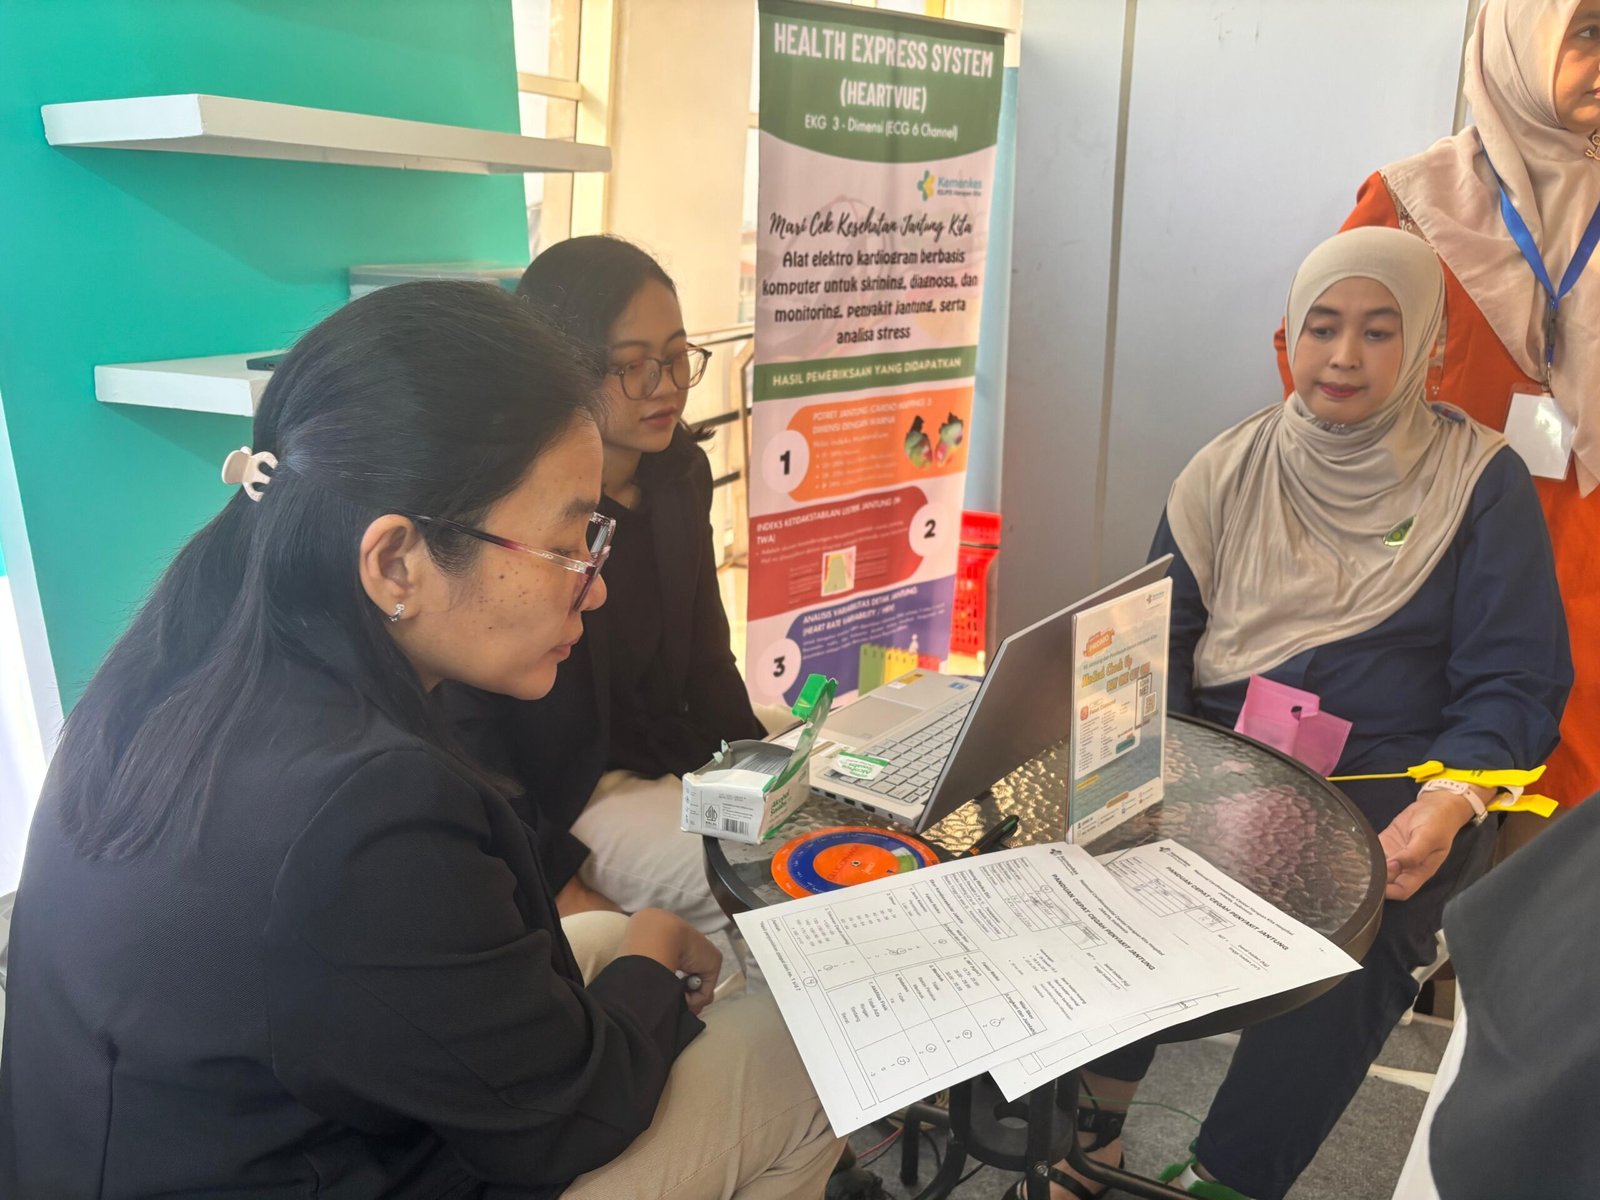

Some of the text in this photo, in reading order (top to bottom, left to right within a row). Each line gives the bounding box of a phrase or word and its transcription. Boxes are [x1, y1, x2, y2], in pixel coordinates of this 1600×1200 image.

[774, 22, 993, 78] HEALTH EXPRESS SYSTEM
[840, 78, 927, 113] (HEARTVUE)
[804, 113, 827, 130] EKG
[832, 117, 839, 131] 3
[848, 117, 884, 134] Dimensi
[885, 120, 909, 137] (ECG
[912, 123, 919, 136] 6
[921, 122, 958, 141] Channel)
[769, 206, 973, 243] Mari Cek Kesehatan Jantung Kita
[783, 249, 965, 268] Alat elektro kardiogram berbasis
[762, 279, 821, 296] komputer
[824, 279, 858, 293] untuk
[861, 275, 907, 292] skrining,
[961, 273, 978, 287] dan
[847, 302, 892, 318] penyakit
[940, 299, 966, 313] serta
[836, 326, 911, 344] analisa stress
[773, 357, 962, 387] HASIL PEMERIKSAAN YANG DIDAPATKAN
[780, 450, 791, 475] 1
[757, 520, 783, 532] INDEKS
[861, 499, 892, 512] JANTUNG
[924, 519, 936, 539] 2
[803, 612, 832, 624] ANALISIS
[773, 656, 786, 678] 3
[1165, 867, 1192, 884] PANDUAN
[1190, 885, 1210, 897] CEPAT
[1208, 898, 1231, 911] CEGAH
[1229, 912, 1259, 929] PENYAKIT
[1257, 930, 1289, 949] JANTUNG
[1051, 874, 1074, 897] PANDUAN
[1072, 898, 1090, 912] CEPAT
[1087, 913, 1107, 928] CEGAH
[1104, 929, 1131, 948] PENYAKIT
[1127, 949, 1156, 970] JANTUNG
